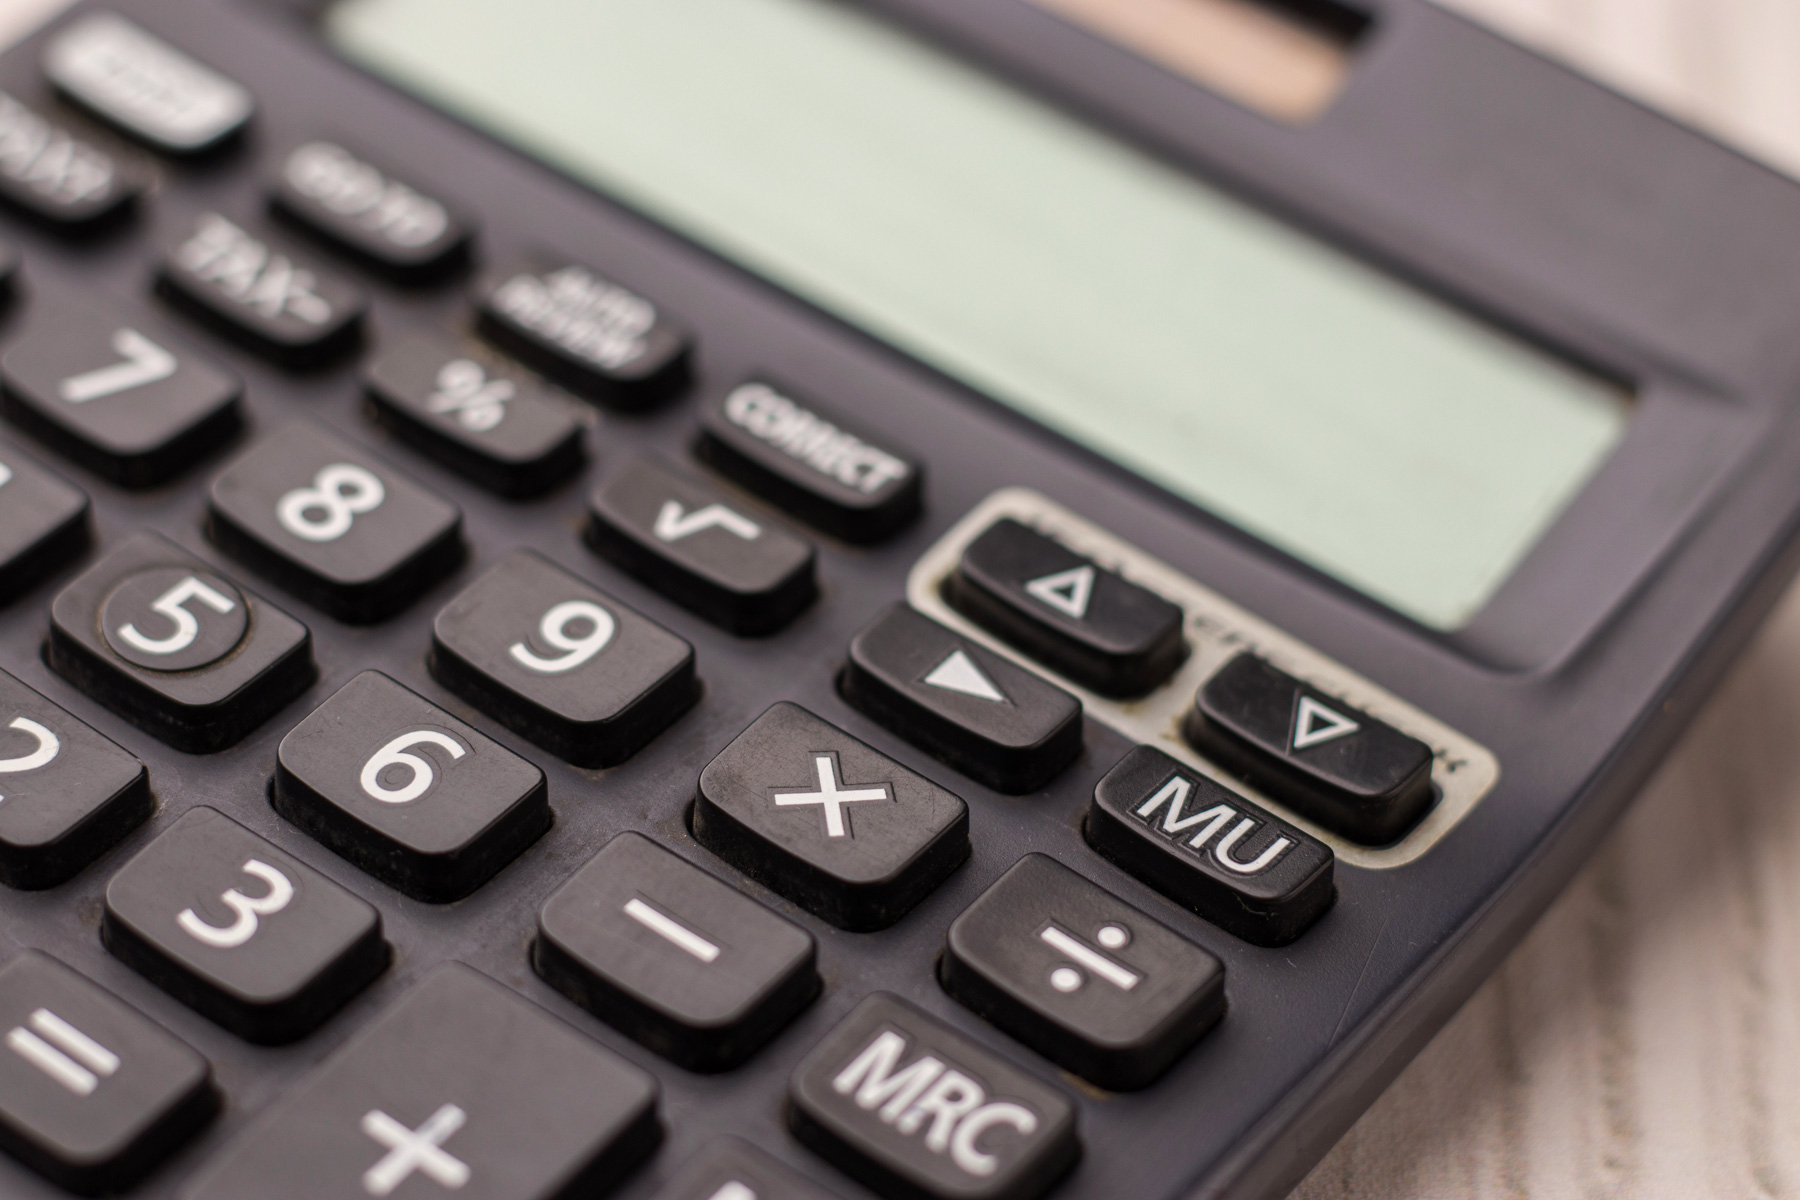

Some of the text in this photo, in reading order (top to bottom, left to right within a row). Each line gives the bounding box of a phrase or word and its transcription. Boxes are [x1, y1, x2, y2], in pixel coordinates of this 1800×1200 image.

[62, 330, 176, 402] 7
[428, 360, 515, 432] %
[725, 382, 908, 494] CORRECT
[278, 465, 384, 540] 8
[118, 577, 235, 654] 5
[509, 601, 614, 673] 9
[360, 730, 466, 804] 6
[1138, 776, 1290, 873] MU
[178, 859, 294, 947] 3
[1041, 927, 1138, 992] ÷
[8, 1008, 119, 1093] =
[832, 1030, 1037, 1176] MRC
[363, 1104, 469, 1194] +
